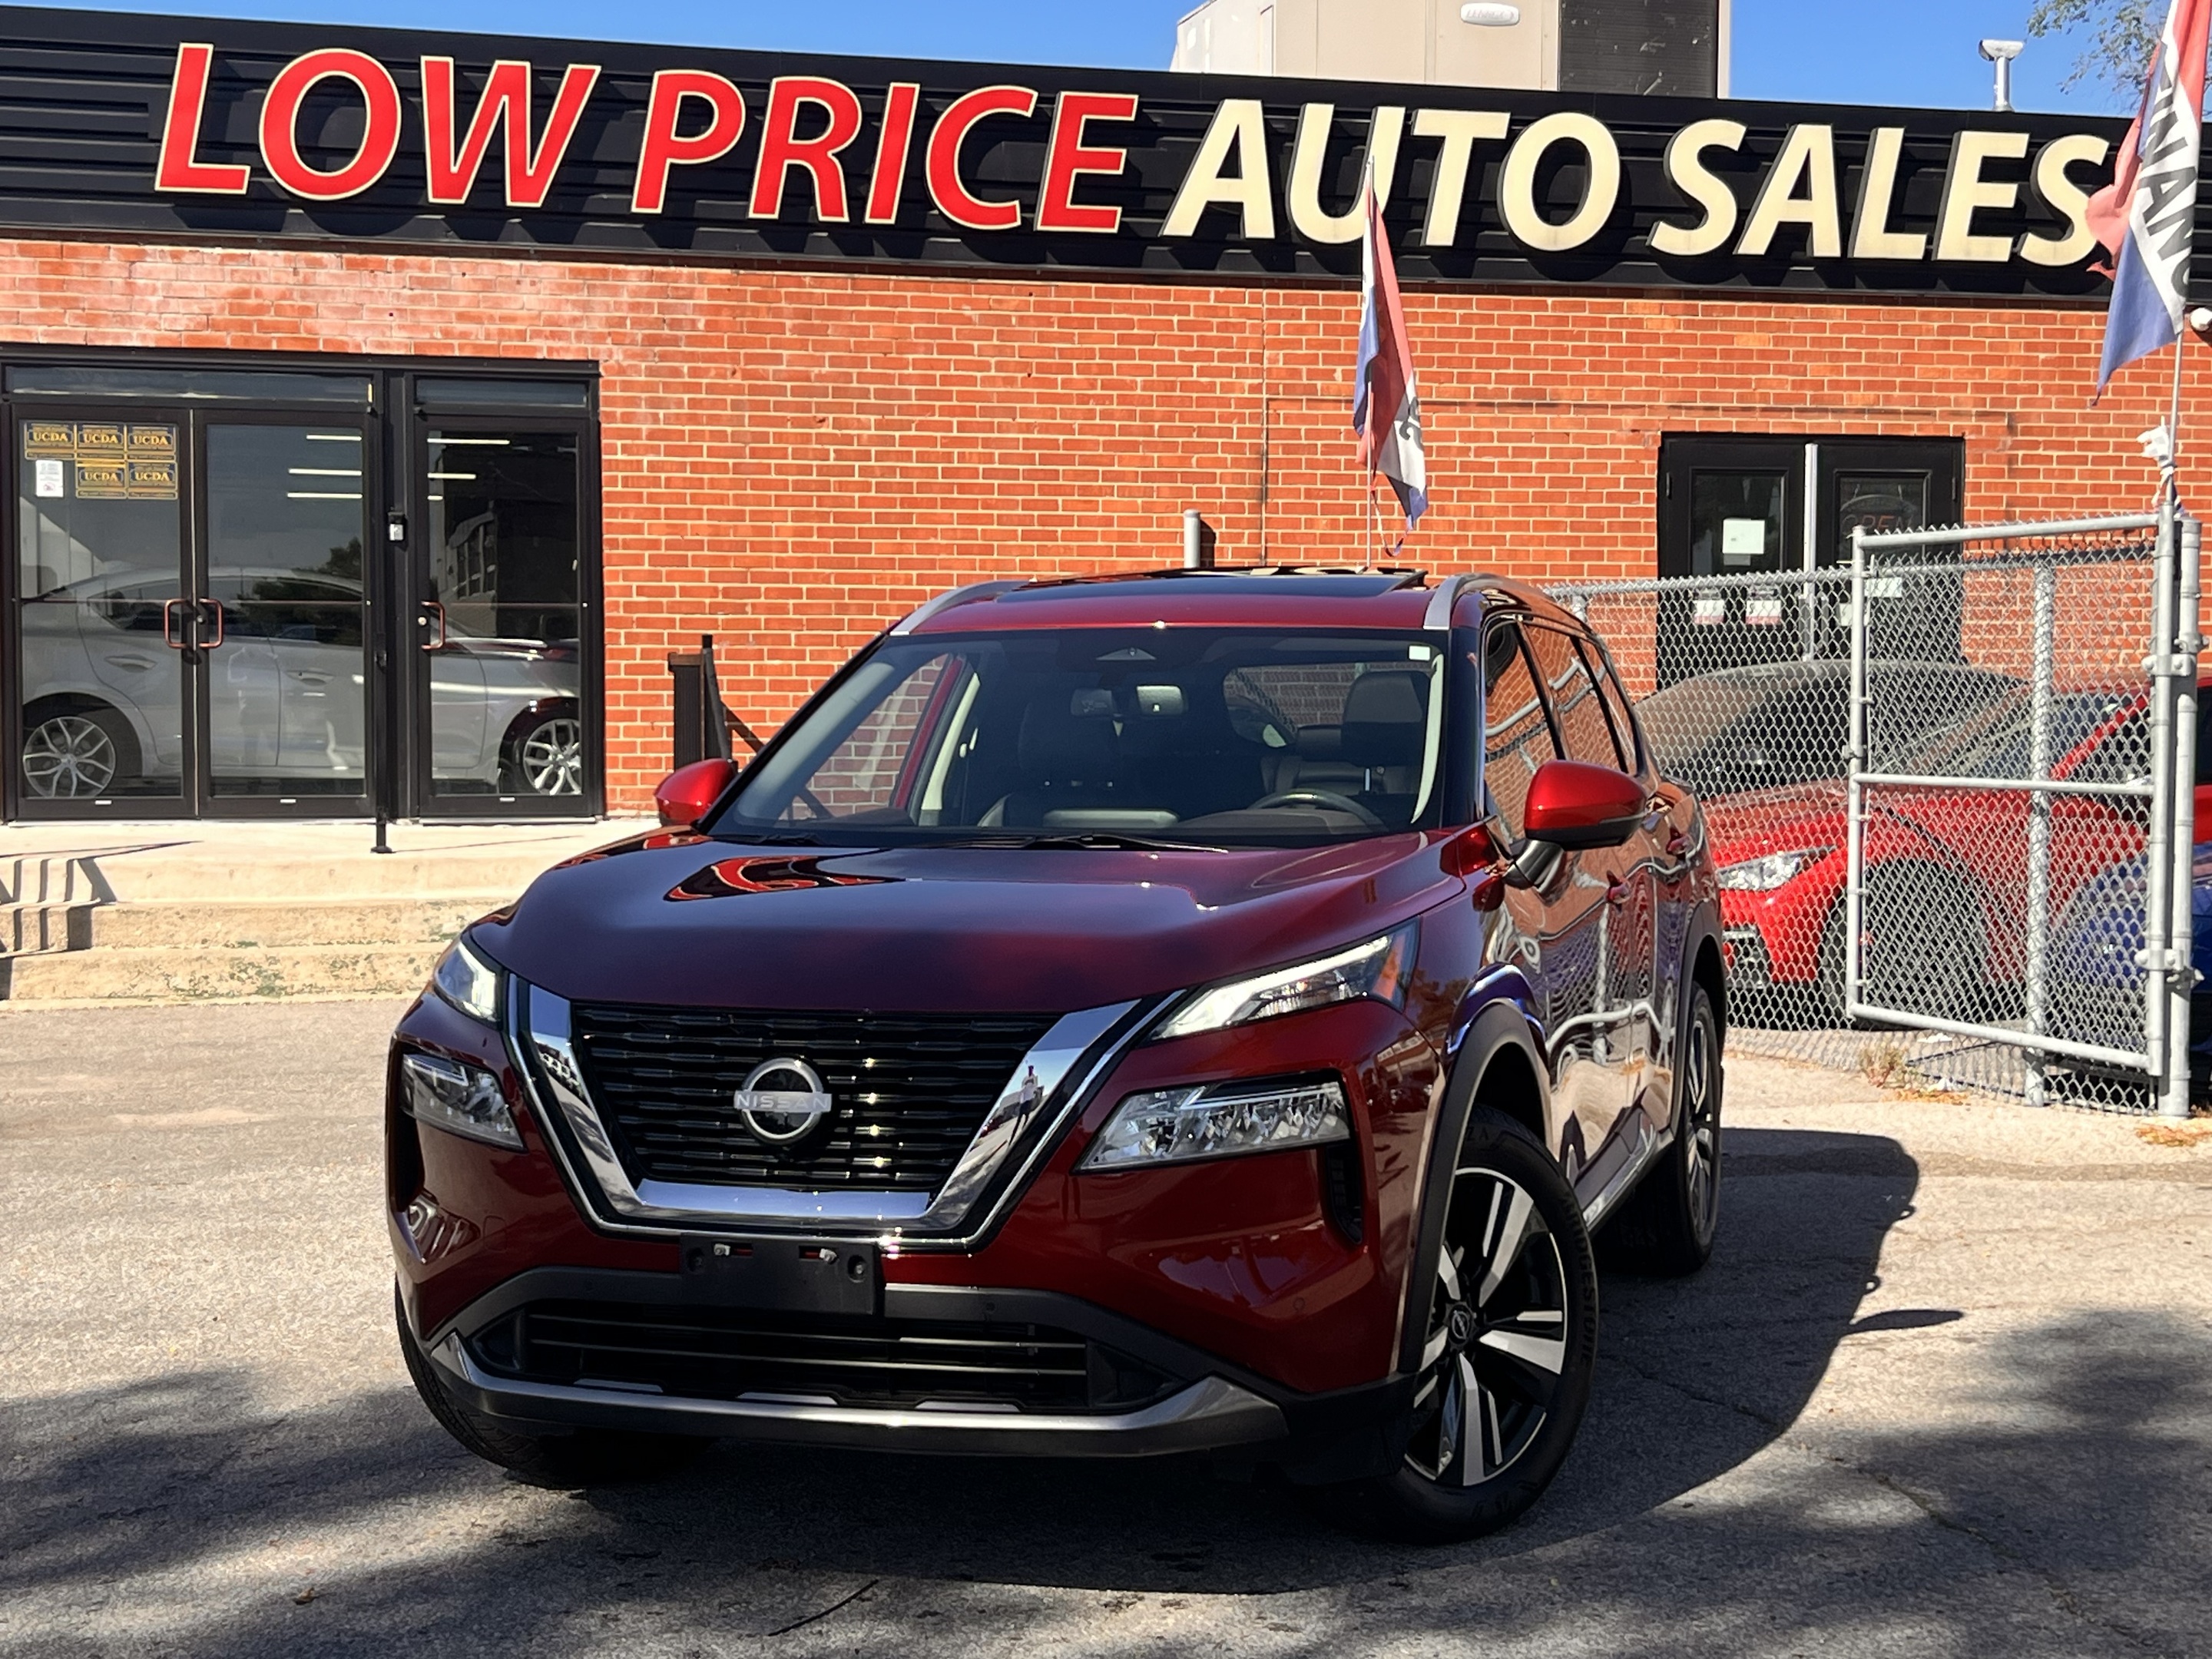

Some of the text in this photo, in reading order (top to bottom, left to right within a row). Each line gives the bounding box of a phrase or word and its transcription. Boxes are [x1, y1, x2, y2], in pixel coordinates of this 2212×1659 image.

[155, 42, 2111, 267] LOW PRICE AUTO SALES
[33, 432, 68, 442] UCDA
[84, 432, 118, 444] UCDA
[134, 435, 168, 445] UCDA
[84, 472, 118, 482] UCDA
[135, 472, 170, 482] UCDA
[736, 1094, 829, 1109] NISSAN
